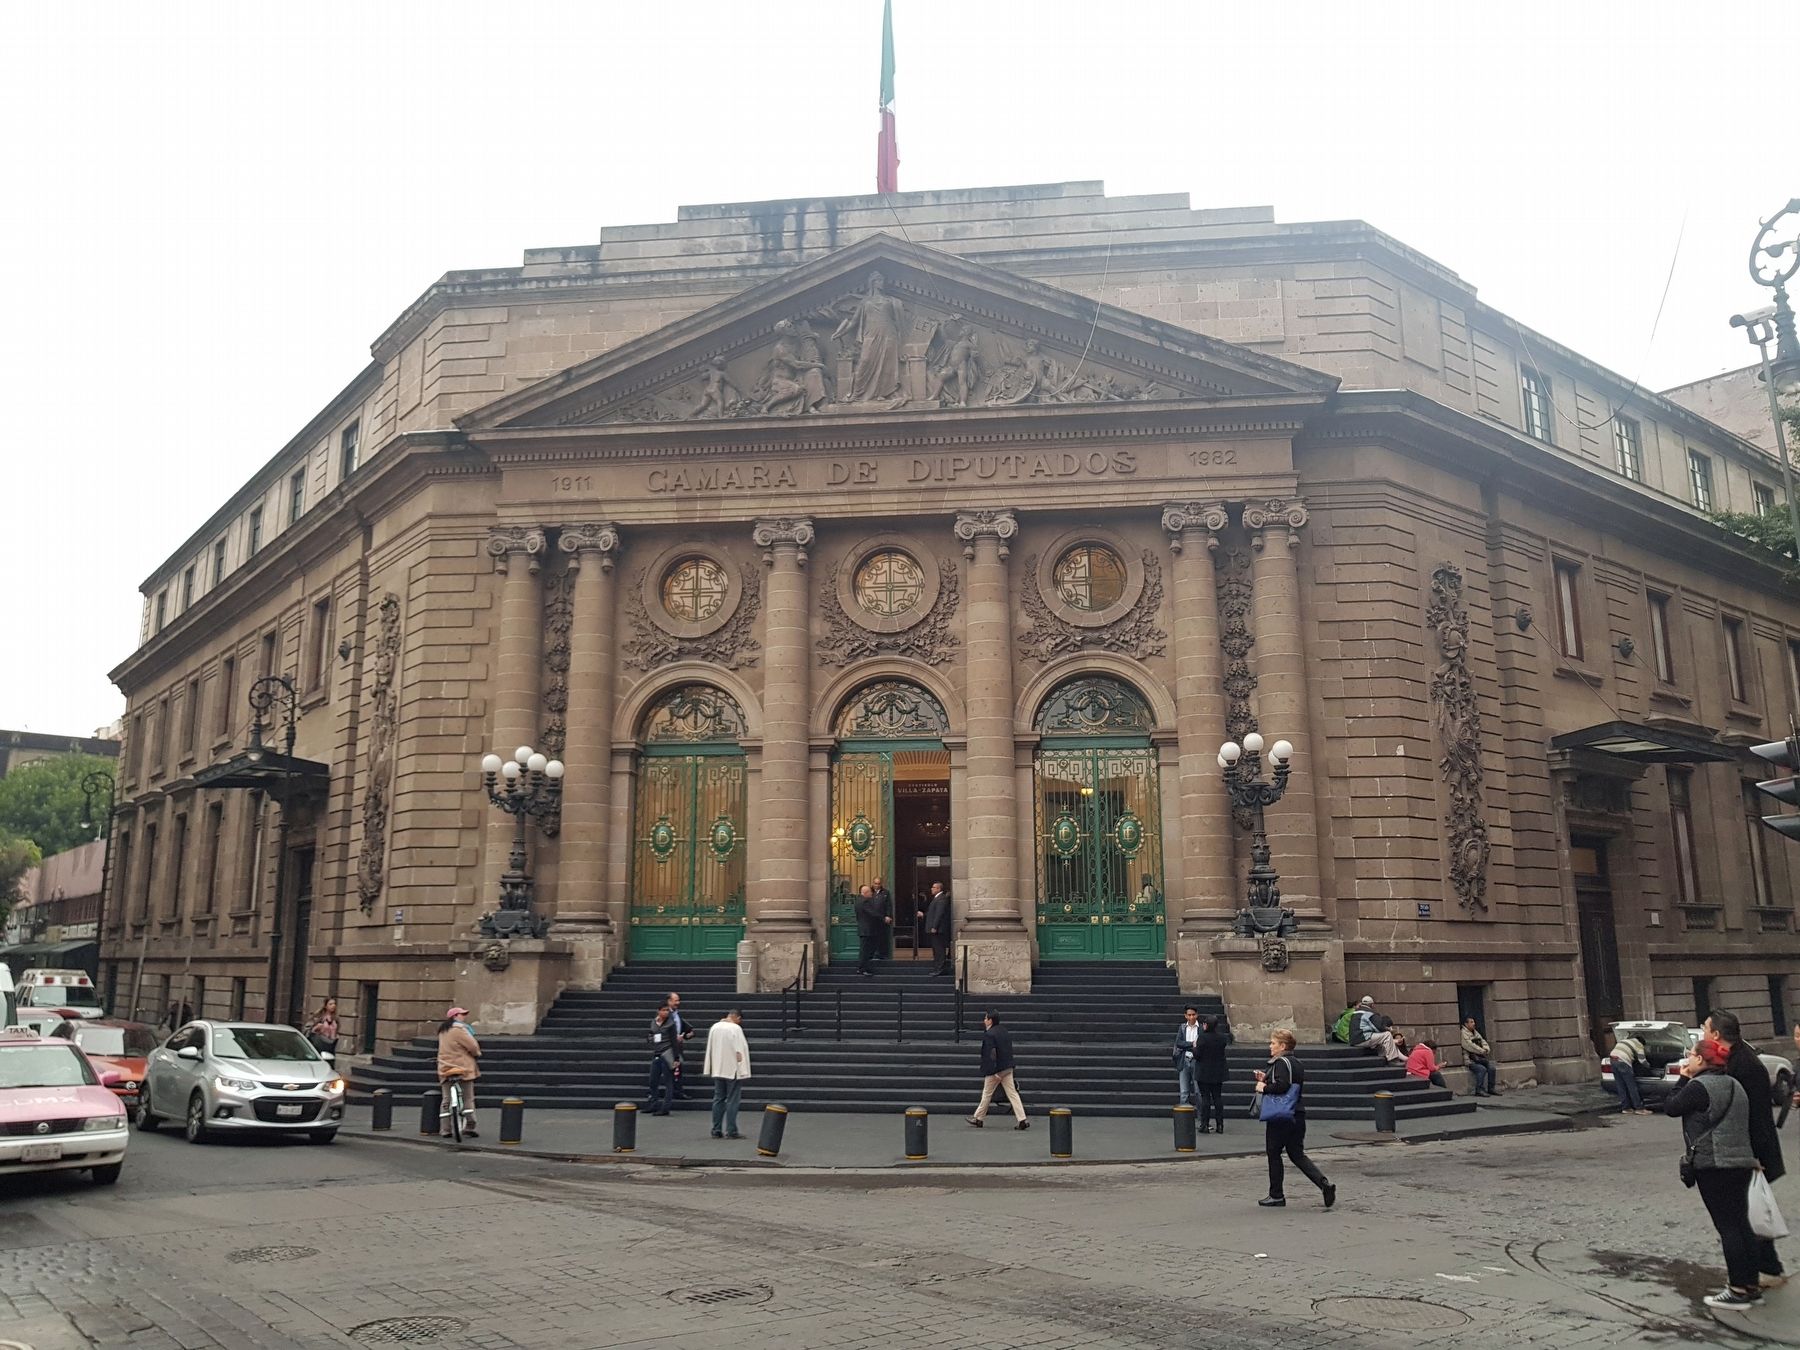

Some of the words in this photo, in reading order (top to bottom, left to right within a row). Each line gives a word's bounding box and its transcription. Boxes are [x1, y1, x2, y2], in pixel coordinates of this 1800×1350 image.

[1189, 450, 1238, 467] 1982
[648, 465, 798, 493] CAMARA
[826, 460, 879, 486] DE
[906, 451, 1137, 483] DIPUTADOS
[552, 475, 592, 492] 1911
